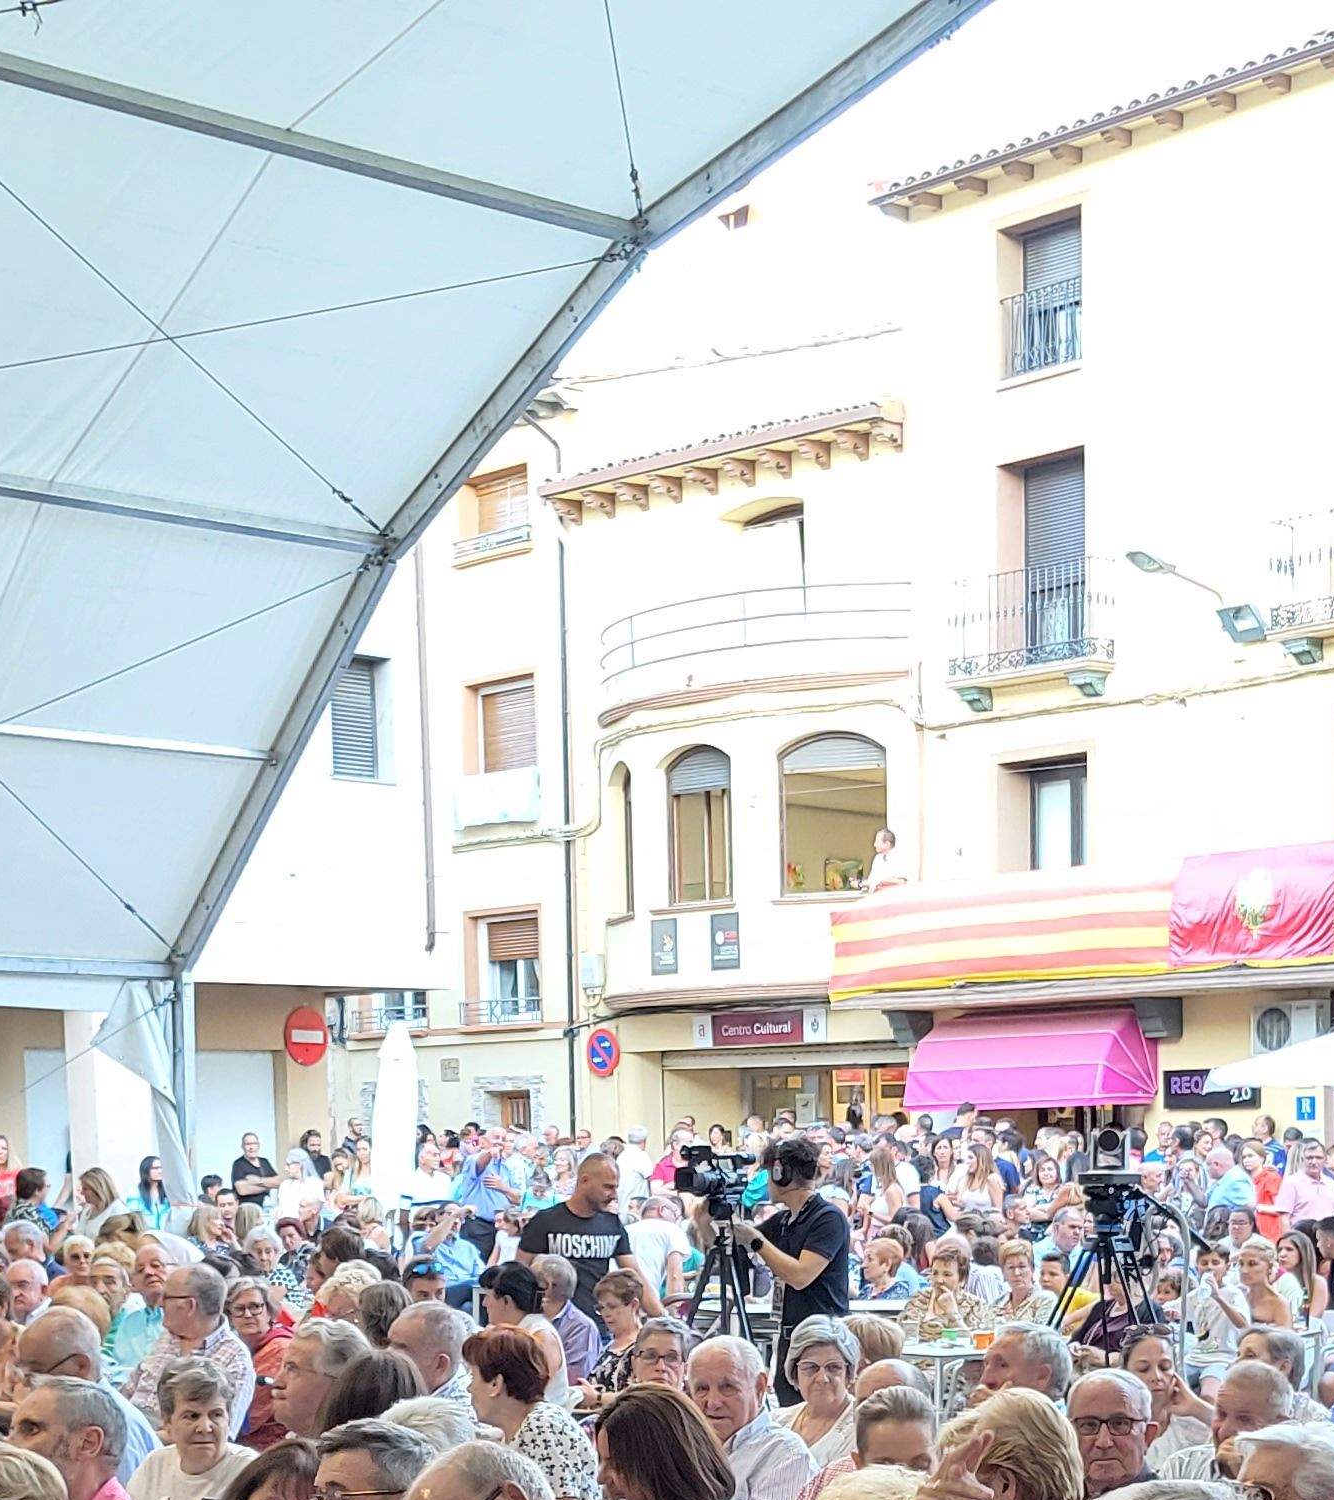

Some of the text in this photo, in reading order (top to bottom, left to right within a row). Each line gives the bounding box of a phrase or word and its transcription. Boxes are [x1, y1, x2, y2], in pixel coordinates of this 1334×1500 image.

[721, 1021, 792, 1036] Centro Cultural
[1230, 1087, 1252, 1104] 2.0
[547, 1232, 622, 1259] MOSCHIN
